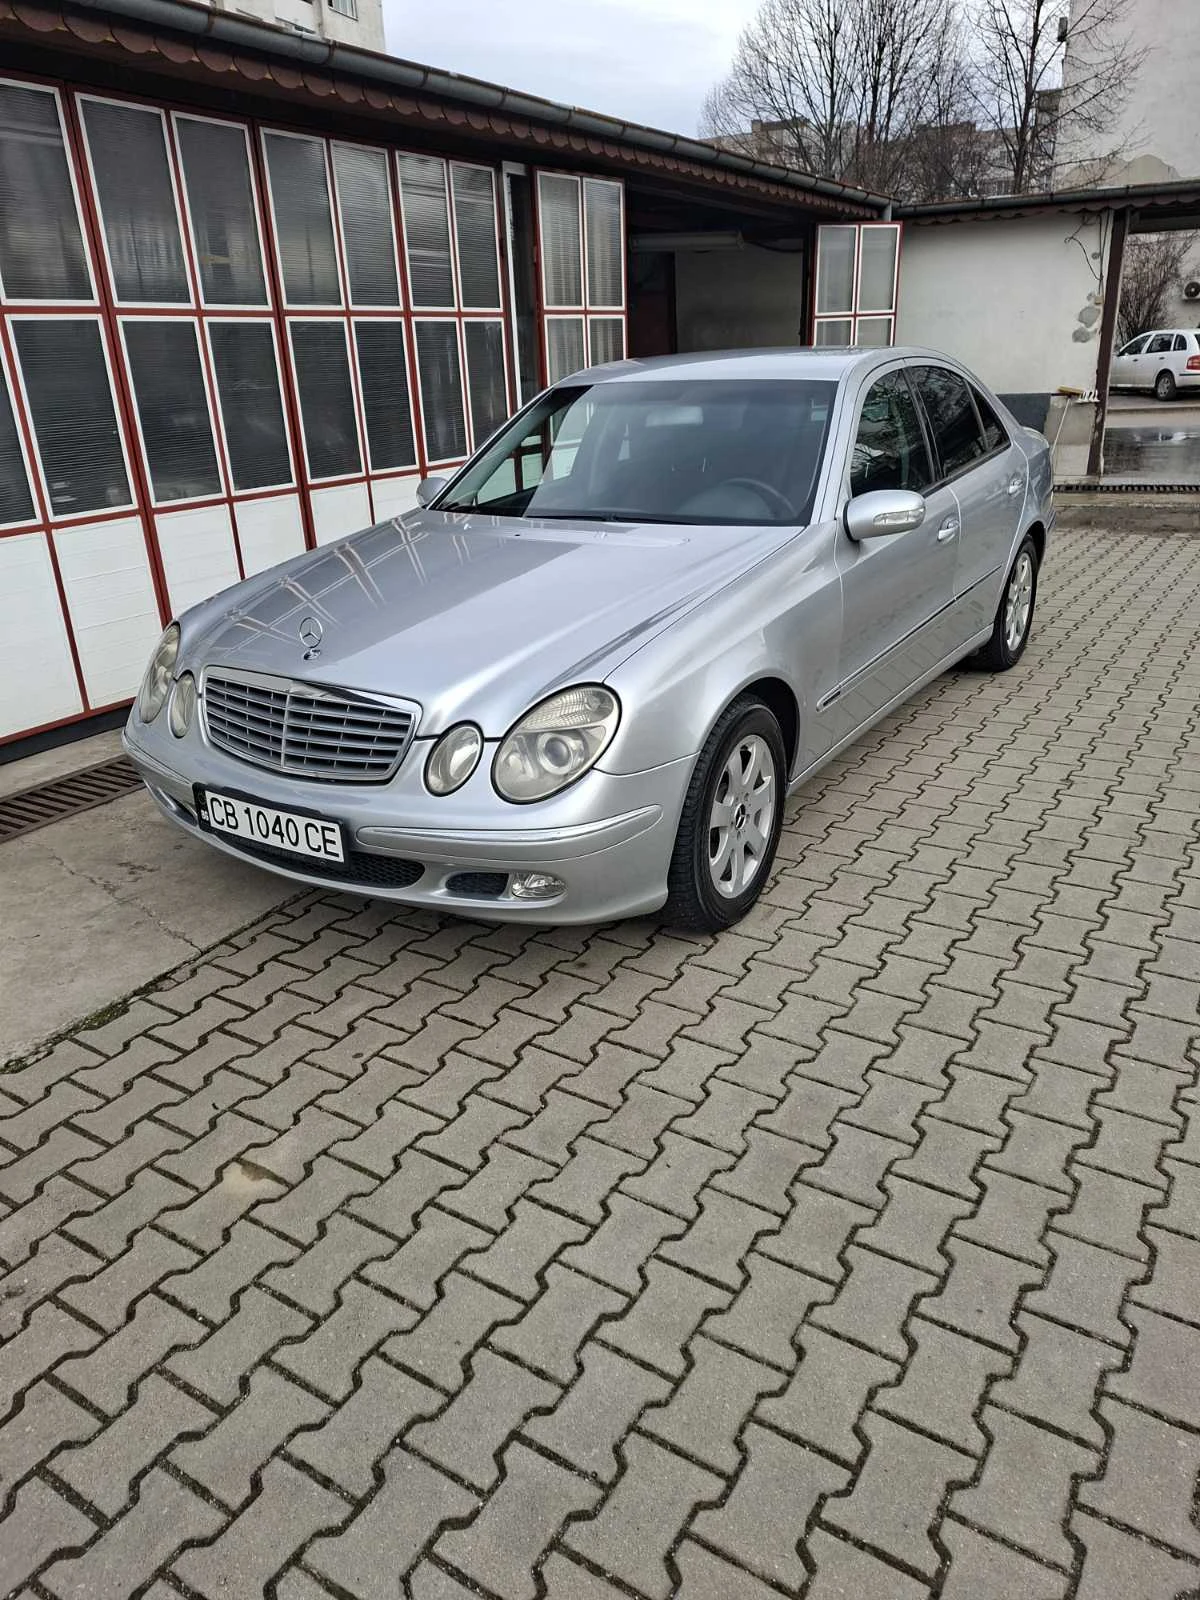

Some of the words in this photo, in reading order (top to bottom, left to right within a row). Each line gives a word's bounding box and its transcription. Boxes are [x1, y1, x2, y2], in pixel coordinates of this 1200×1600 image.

[210, 797, 238, 829] CB
[244, 807, 299, 846] 1040
[304, 822, 339, 857] CE
